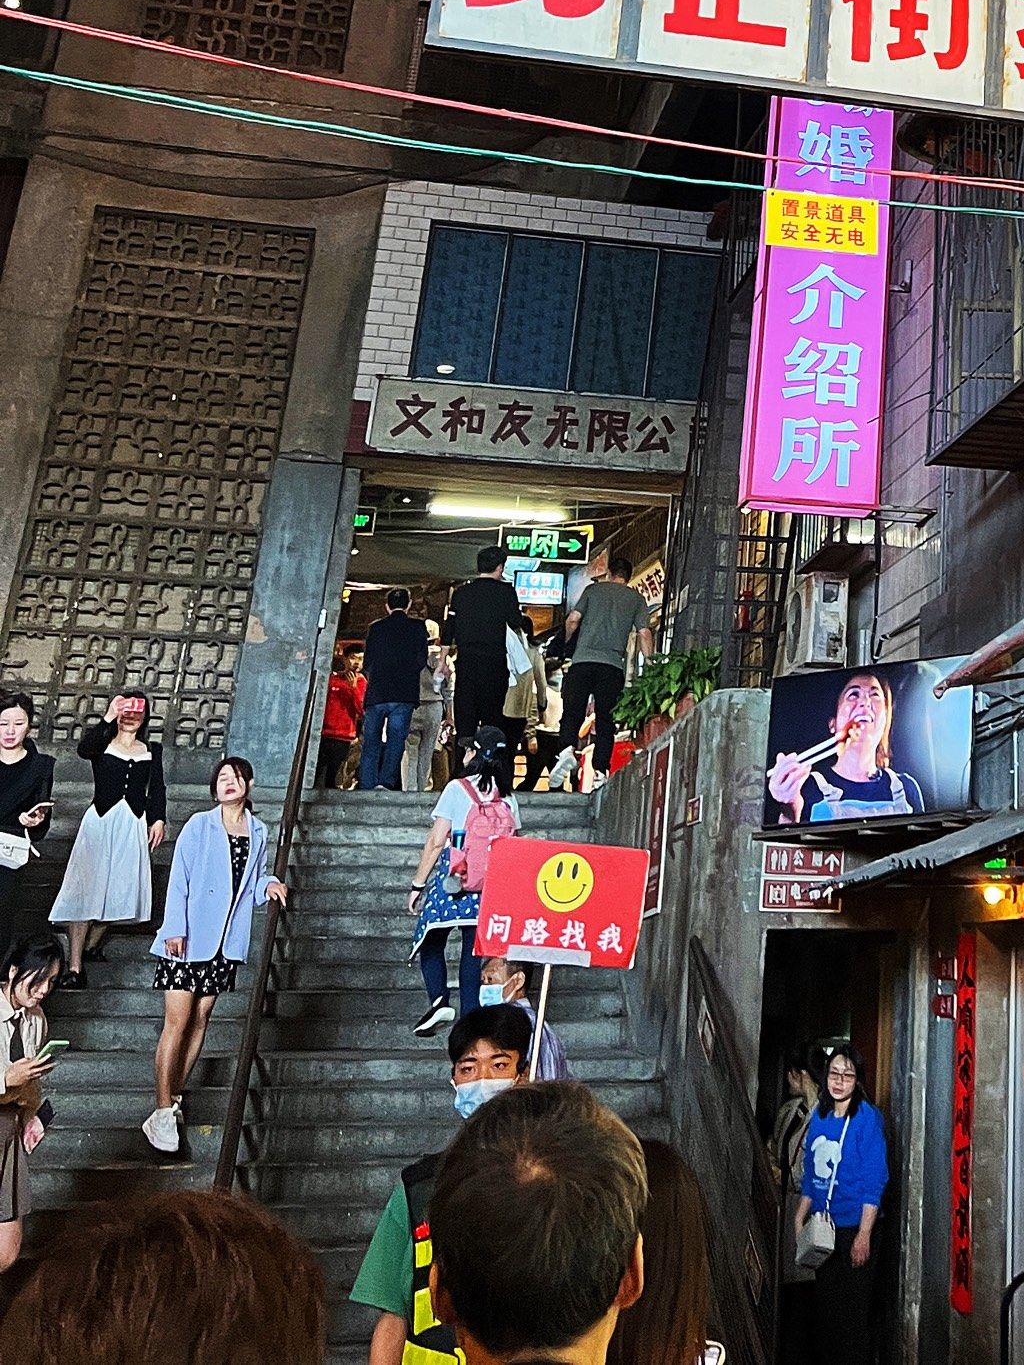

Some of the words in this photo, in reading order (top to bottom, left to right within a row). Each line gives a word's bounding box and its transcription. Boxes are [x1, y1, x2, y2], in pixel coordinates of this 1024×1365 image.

[781, 198, 866, 224] 置景道具
[781, 221, 866, 247] 安全无电
[389, 393, 698, 455] 文和友无限公
[486, 913, 623, 954] 问路找我
